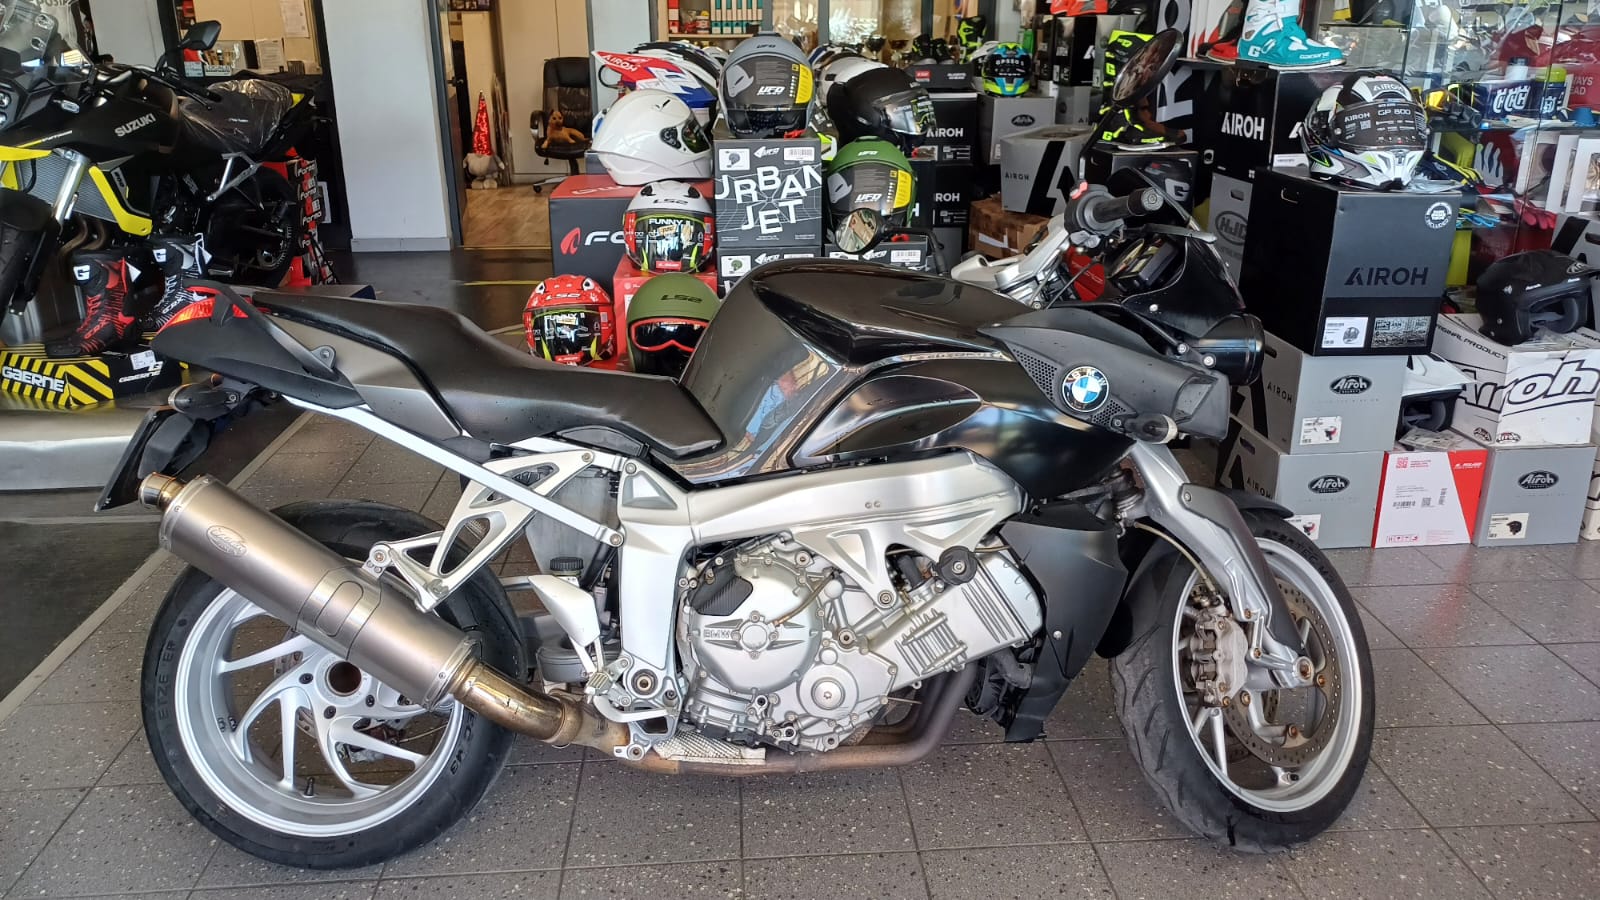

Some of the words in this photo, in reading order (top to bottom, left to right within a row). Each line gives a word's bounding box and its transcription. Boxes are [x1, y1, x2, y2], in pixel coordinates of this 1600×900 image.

[604, 54, 640, 72] AIROH
[1573, 76, 1594, 86] AYS
[1373, 83, 1403, 92] AIROH
[1570, 86, 1586, 95] EAD
[1344, 112, 1371, 122] AIROH
[114, 112, 157, 137] SUZUKI
[1221, 112, 1265, 141] AIROH
[926, 127, 964, 138] AIROH
[1005, 172, 1029, 180] AIROH
[855, 193, 882, 202] UFO
[935, 193, 960, 202] ROH
[741, 198, 803, 235] JET
[1343, 266, 1429, 286] AIROH
[1463, 337, 1508, 361] PRODUCT
[1333, 377, 1367, 391] Airoh
[1267, 381, 1292, 404] AIROH
[1311, 478, 1346, 489] Airoh
[1520, 473, 1555, 485] Airoh
[704, 629, 730, 639] BMW
